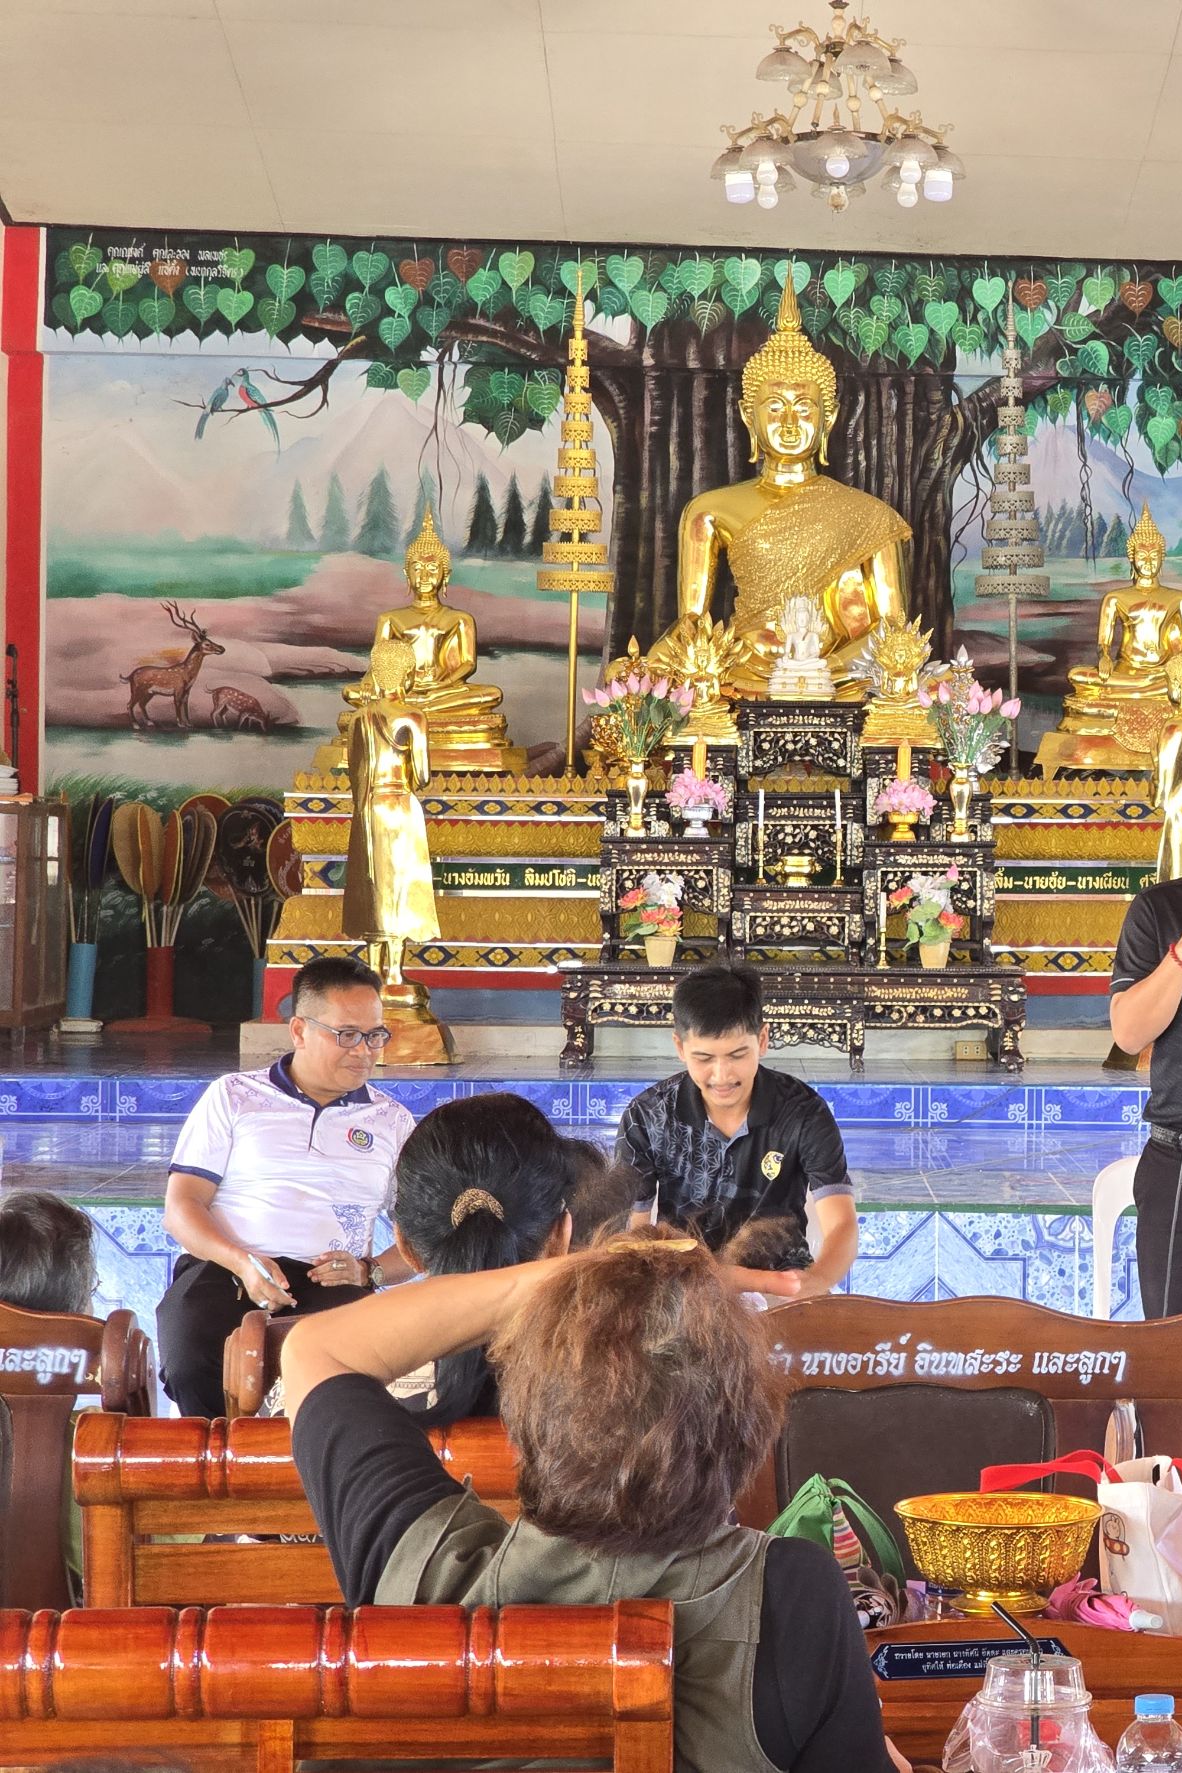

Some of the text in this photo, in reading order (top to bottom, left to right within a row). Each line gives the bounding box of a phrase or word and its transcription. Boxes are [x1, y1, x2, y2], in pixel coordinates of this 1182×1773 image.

[801, 1332, 911, 1376] นางอารีย์
[1032, 1350, 1128, 1385] และลูกๆ
